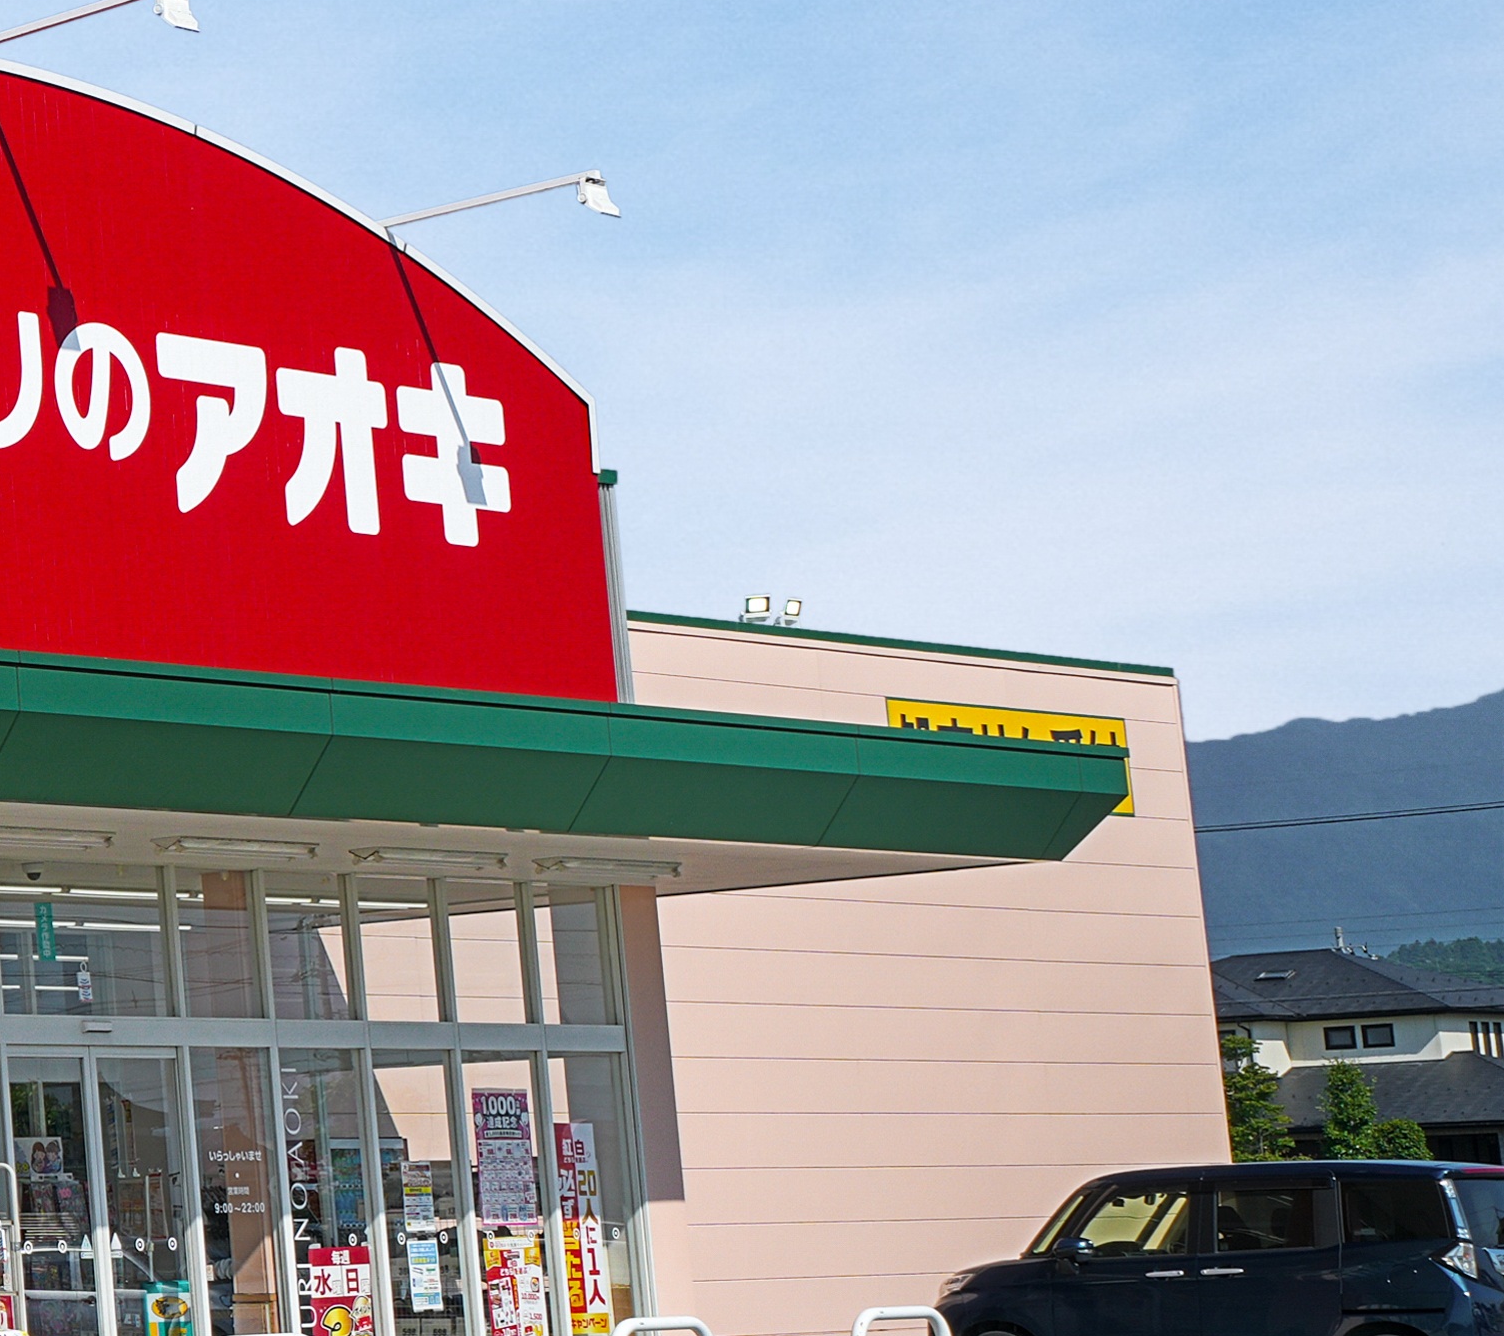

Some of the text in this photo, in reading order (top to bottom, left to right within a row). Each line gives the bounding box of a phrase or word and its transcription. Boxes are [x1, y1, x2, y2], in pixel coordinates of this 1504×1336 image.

[208, 1150, 262, 1161] いらっしゃいませ
